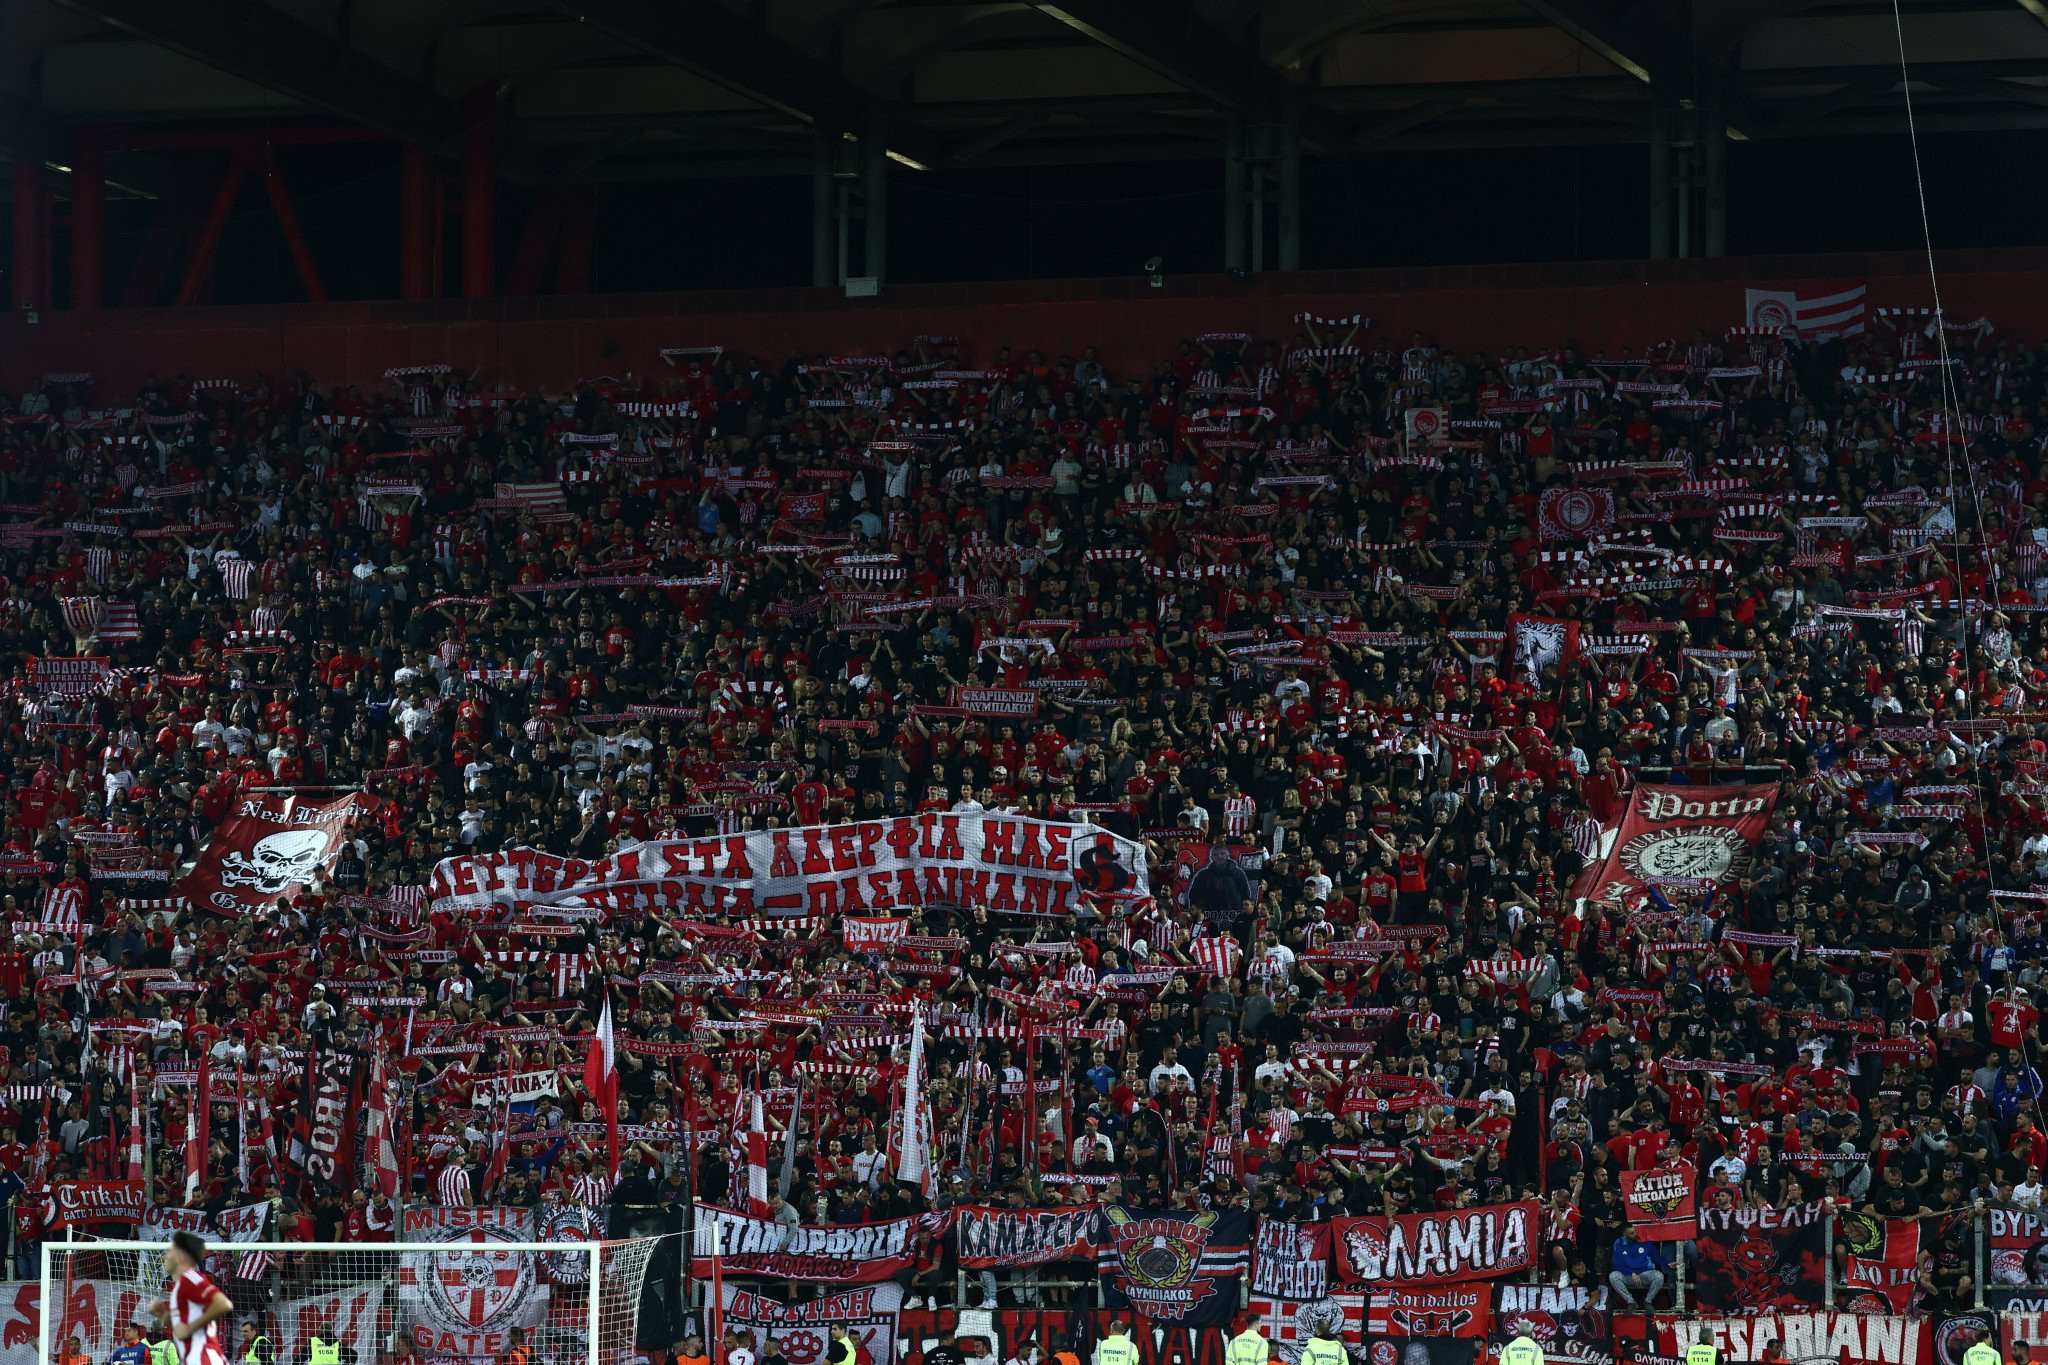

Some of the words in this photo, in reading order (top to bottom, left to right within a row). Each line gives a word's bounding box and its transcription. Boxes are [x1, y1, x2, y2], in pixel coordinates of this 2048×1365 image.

[1869, 590, 1910, 598] OLYMPIACOS
[37, 661, 98, 674] ΛΙΟΔΩΡΑ
[970, 691, 1035, 704] ΚΑΡΠΕΝΗΣΙ
[963, 703, 1034, 715] ΟΛΥΜΠΙΑΚΟΣ
[240, 801, 286, 823] Nea
[292, 804, 370, 825] Liosia
[662, 807, 714, 817] OLYMPIAKOS
[663, 836, 753, 879] ΣΤΑ
[770, 813, 963, 878] ΑΔΕΡΦΙΑ
[981, 819, 1071, 871] ΜΑΣ
[1620, 827, 1689, 864] NATURAL
[1699, 826, 1750, 852] BORN
[580, 880, 755, 918] ΠΕΙΡΑΙΑ
[806, 866, 1072, 918] ΠΑΣΑΛΙΜΑΝΙ
[211, 891, 271, 920] Gat
[541, 908, 582, 916] OLYMPIACOS
[909, 938, 956, 948] ΟΛΥΜΠΙΑΚΟΣ
[896, 965, 943, 973] OLYMPIACOS
[1114, 974, 1131, 984] 100
[1135, 970, 1172, 982] YEARS
[1117, 991, 1133, 1000] STAR
[1604, 988, 1655, 1002] Olympiakos
[634, 1042, 688, 1054] OLYMPIACOS
[1370, 1075, 1411, 1088] GATE
[1781, 1152, 1810, 1161] ΑΓΙΟΣ
[1634, 1173, 1684, 1192] ΑΓΙΟΣ
[58, 1184, 144, 1209] Trikala
[1629, 1186, 1690, 1204] ΝΙΚΟΛΑΟΣ
[64, 1209, 87, 1221] GATE
[405, 1206, 529, 1233] MISFIT
[1698, 1199, 1824, 1231] ΚΥΨΕΛΗ
[694, 1207, 908, 1261] ΜΕΤΑΜΟΡΦΩΣΗ
[960, 1206, 1104, 1259] ΚΑΜΑΤΕΡΟ
[1107, 1217, 1214, 1247] ΚΟΛΩΝΟΣ
[1257, 1219, 1297, 1254] ΑΓΙΑ
[1385, 1207, 1528, 1279] ΛΑΜΙΑ
[1252, 1258, 1327, 1300] ΒΑΡΒΑΡΑ
[1387, 1288, 1479, 1310] Koridallos
[1412, 1318, 1427, 1333] G
[1438, 1318, 1452, 1332] A
[413, 1324, 502, 1356] GATE
